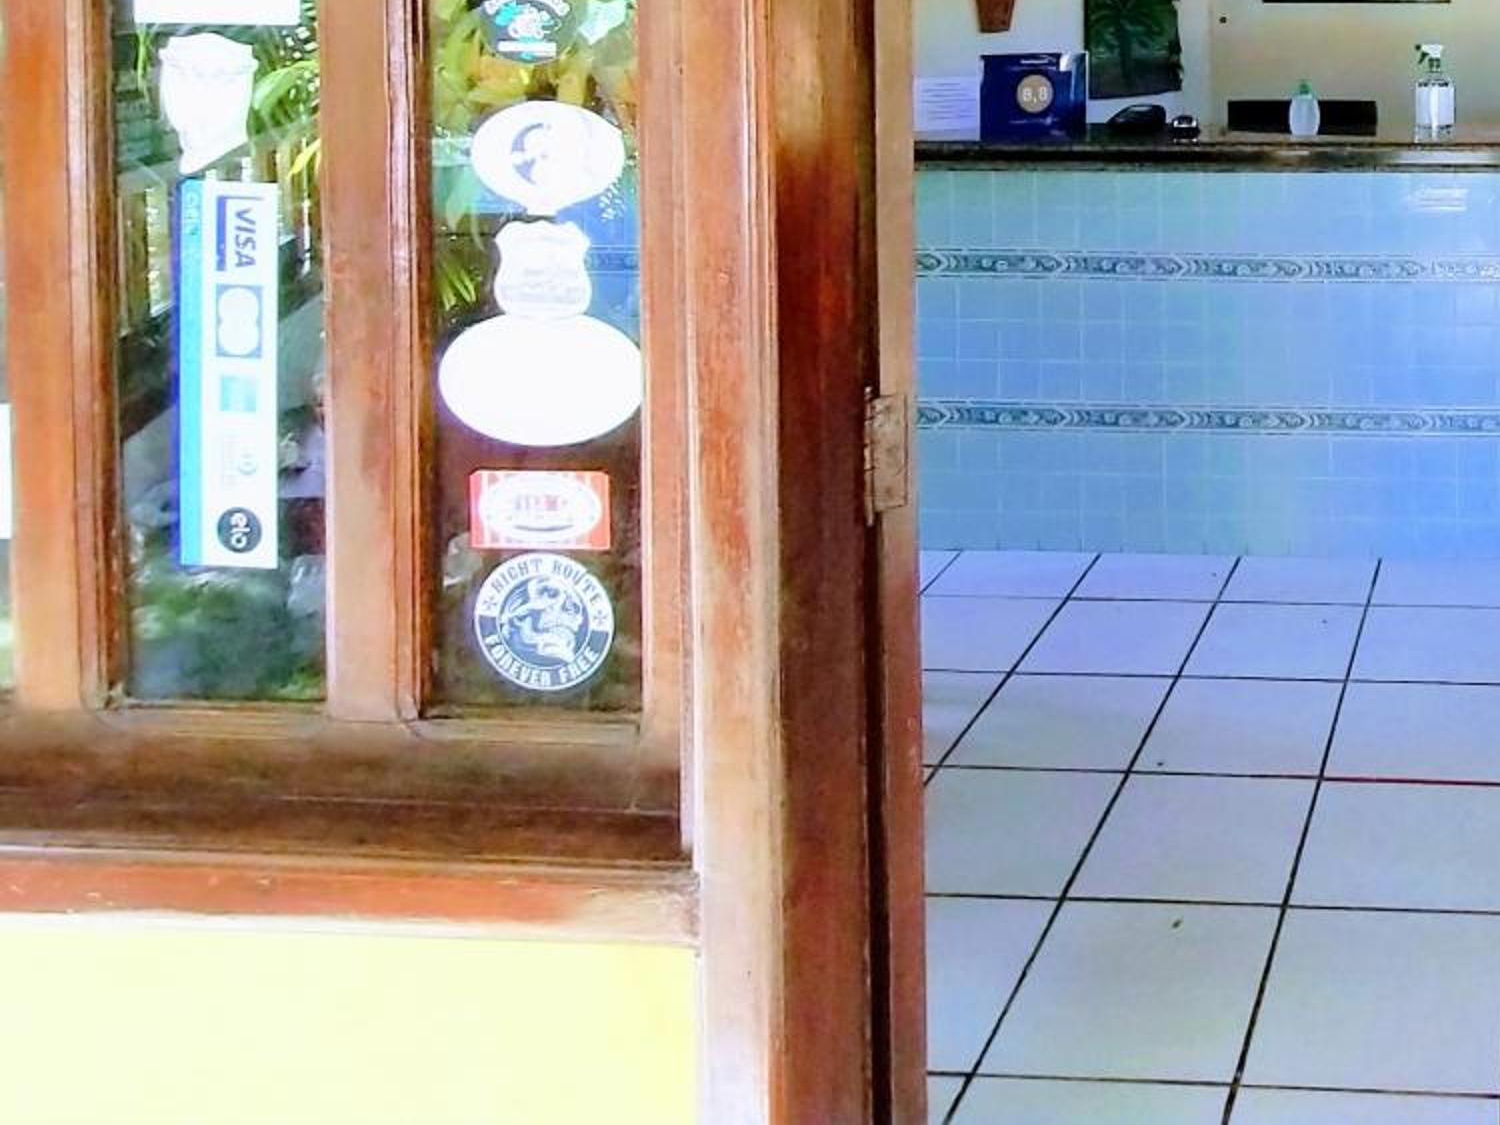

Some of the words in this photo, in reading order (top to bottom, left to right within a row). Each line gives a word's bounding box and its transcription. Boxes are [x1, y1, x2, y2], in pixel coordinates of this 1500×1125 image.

[234, 206, 257, 268] VISA
[484, 634, 552, 686] FOREVER
[558, 645, 600, 684] FREE
